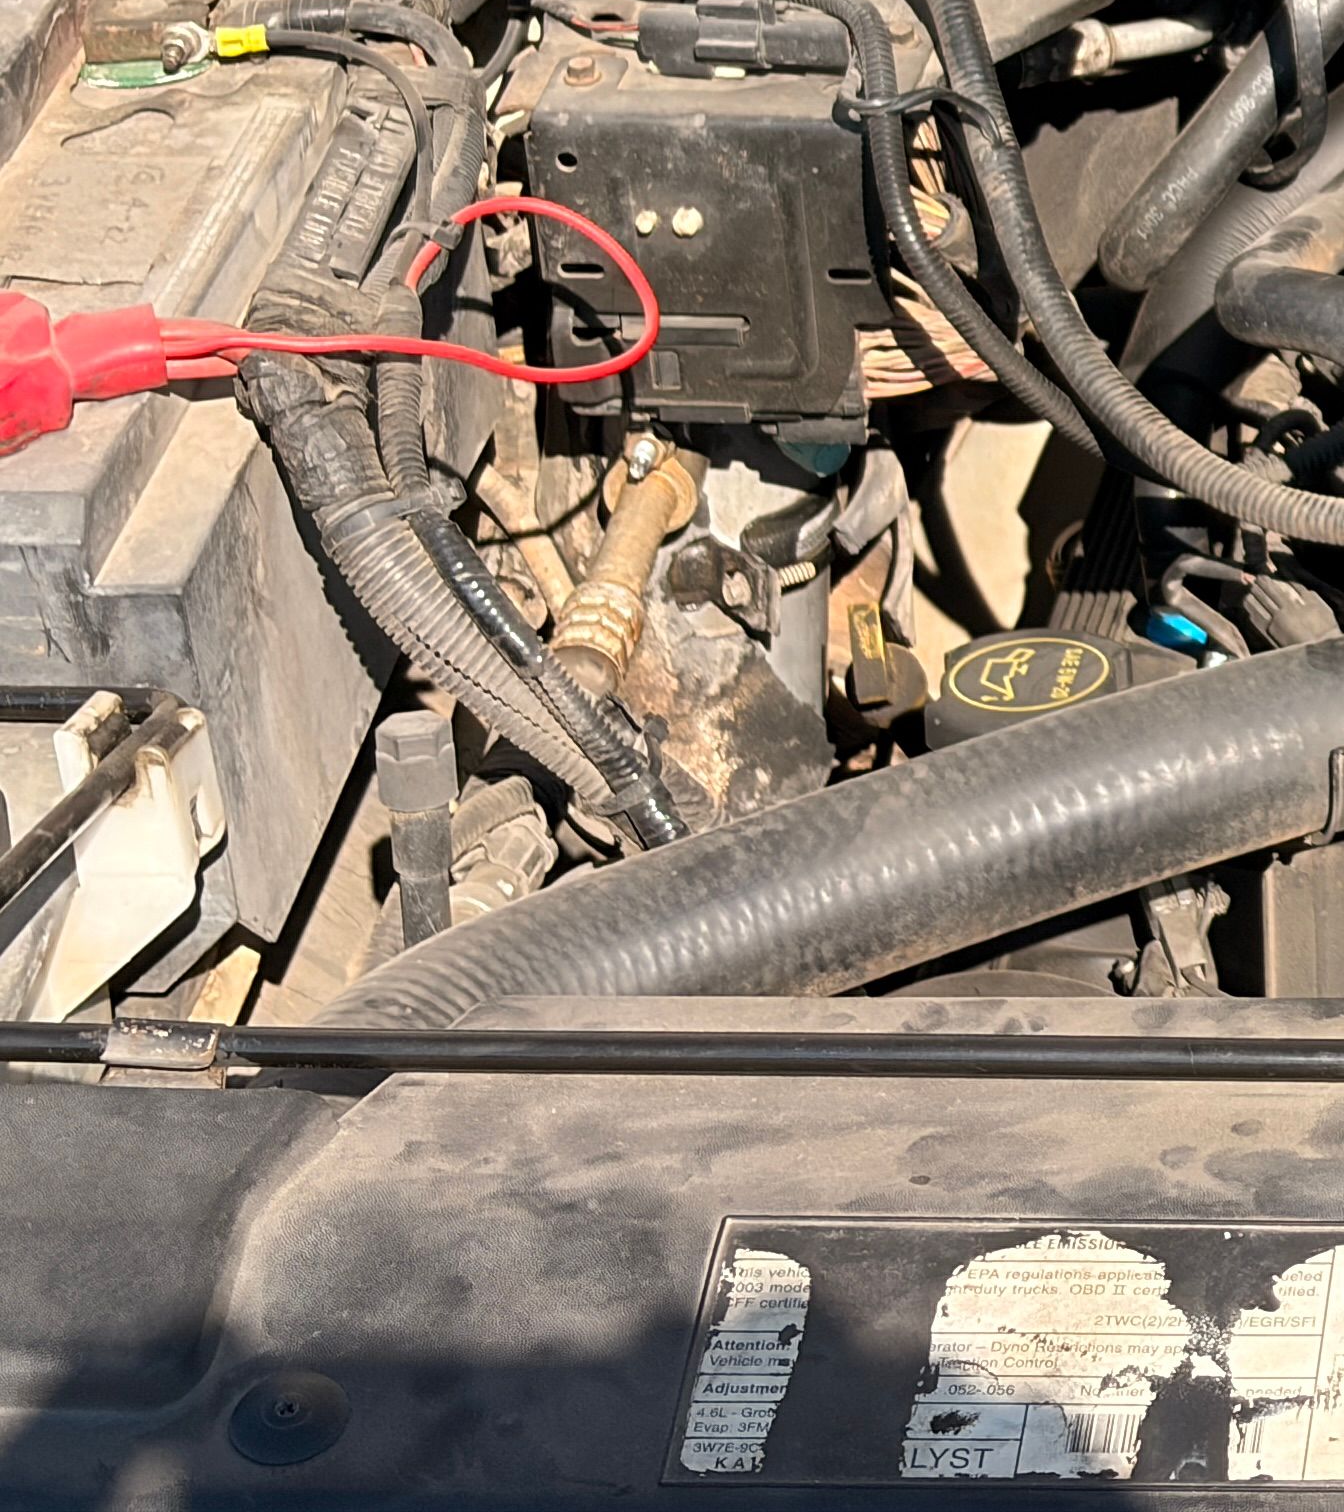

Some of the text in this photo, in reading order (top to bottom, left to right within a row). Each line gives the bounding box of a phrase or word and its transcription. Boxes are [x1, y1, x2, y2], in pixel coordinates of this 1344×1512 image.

[967, 1268, 999, 1280] EPA
[1005, 1269, 1092, 1281] regulations
[1069, 1284, 1106, 1296] OBD
[990, 1342, 1030, 1356] Dyno
[1127, 1344, 1160, 1357] may
[710, 1355, 763, 1367] Vehicle
[1003, 1357, 1059, 1368] Control
